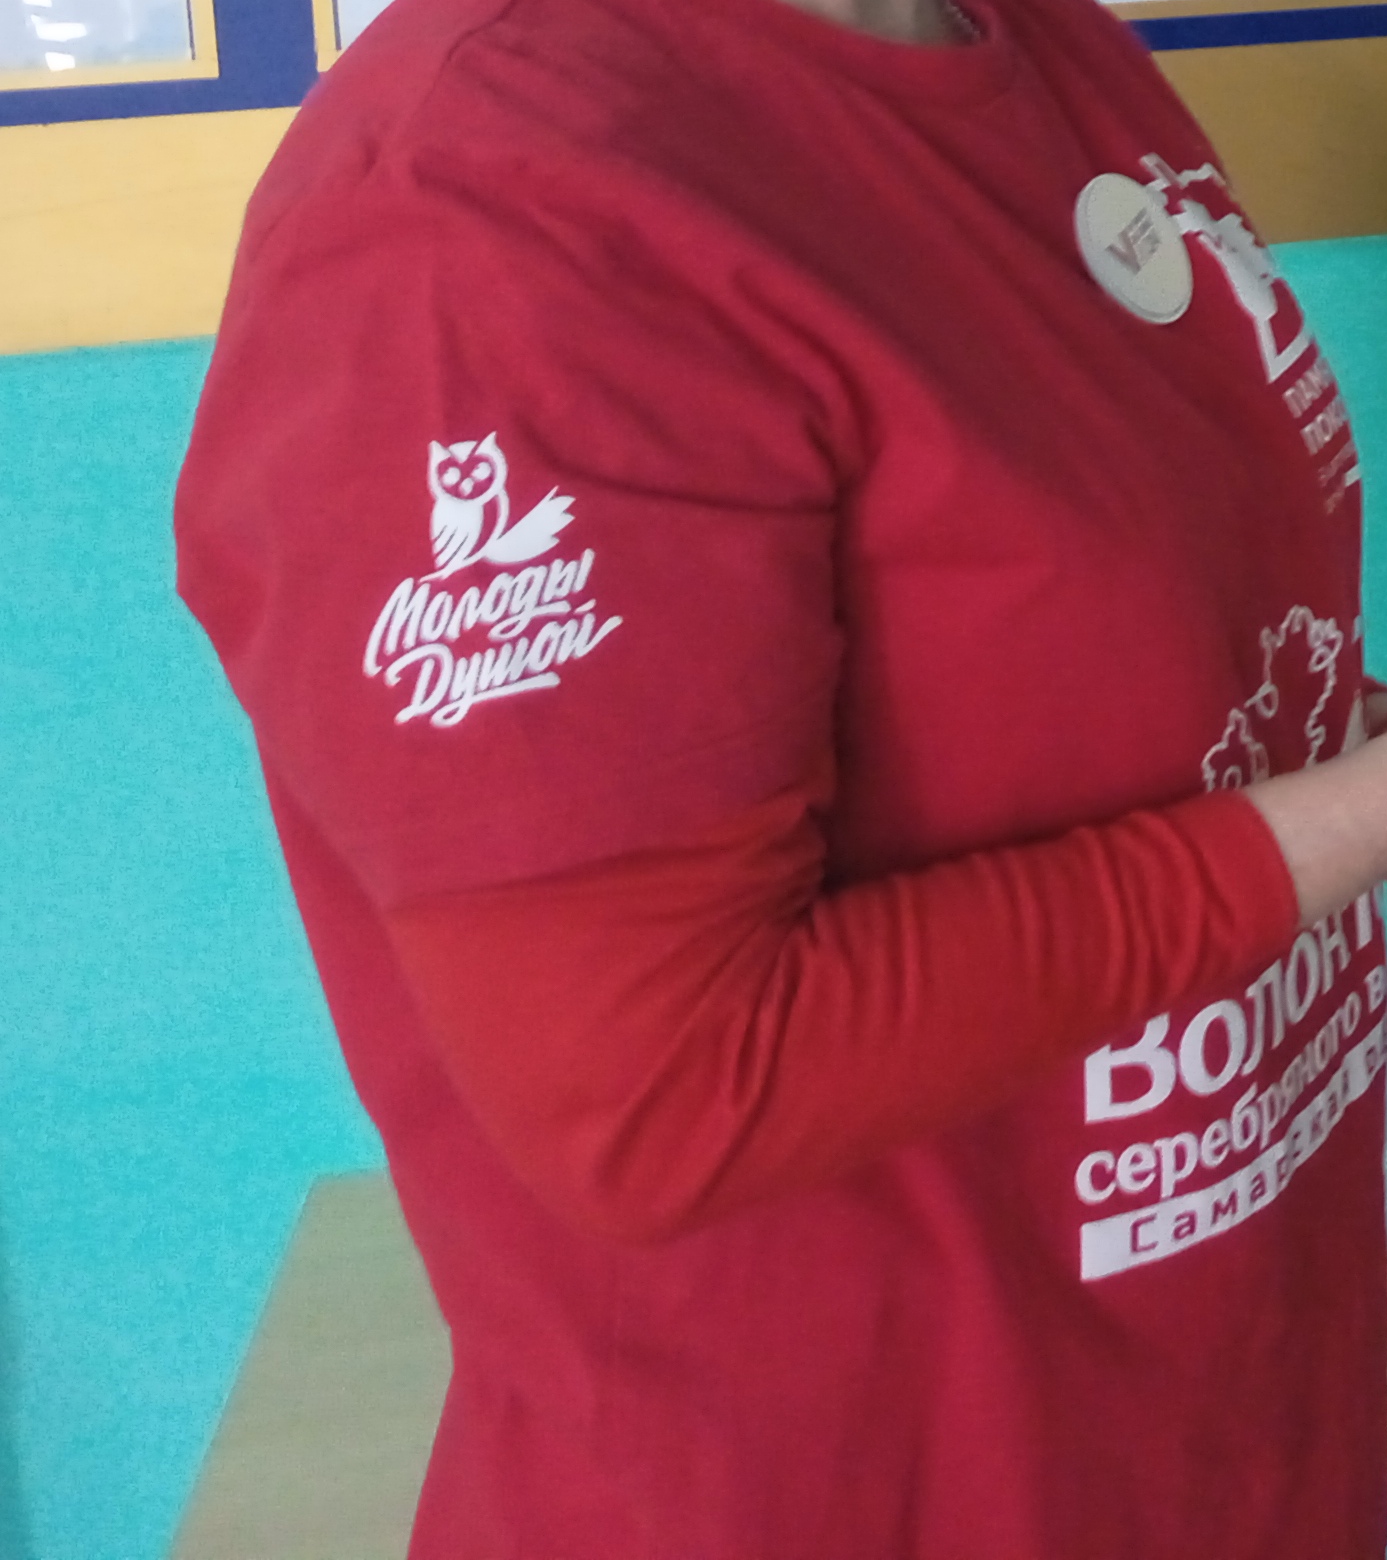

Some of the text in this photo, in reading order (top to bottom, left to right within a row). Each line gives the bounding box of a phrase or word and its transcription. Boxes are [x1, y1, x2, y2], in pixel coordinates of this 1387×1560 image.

[363, 548, 595, 678] Молоды
[385, 599, 623, 728] Душой
[1075, 993, 1361, 1206] серебряного
